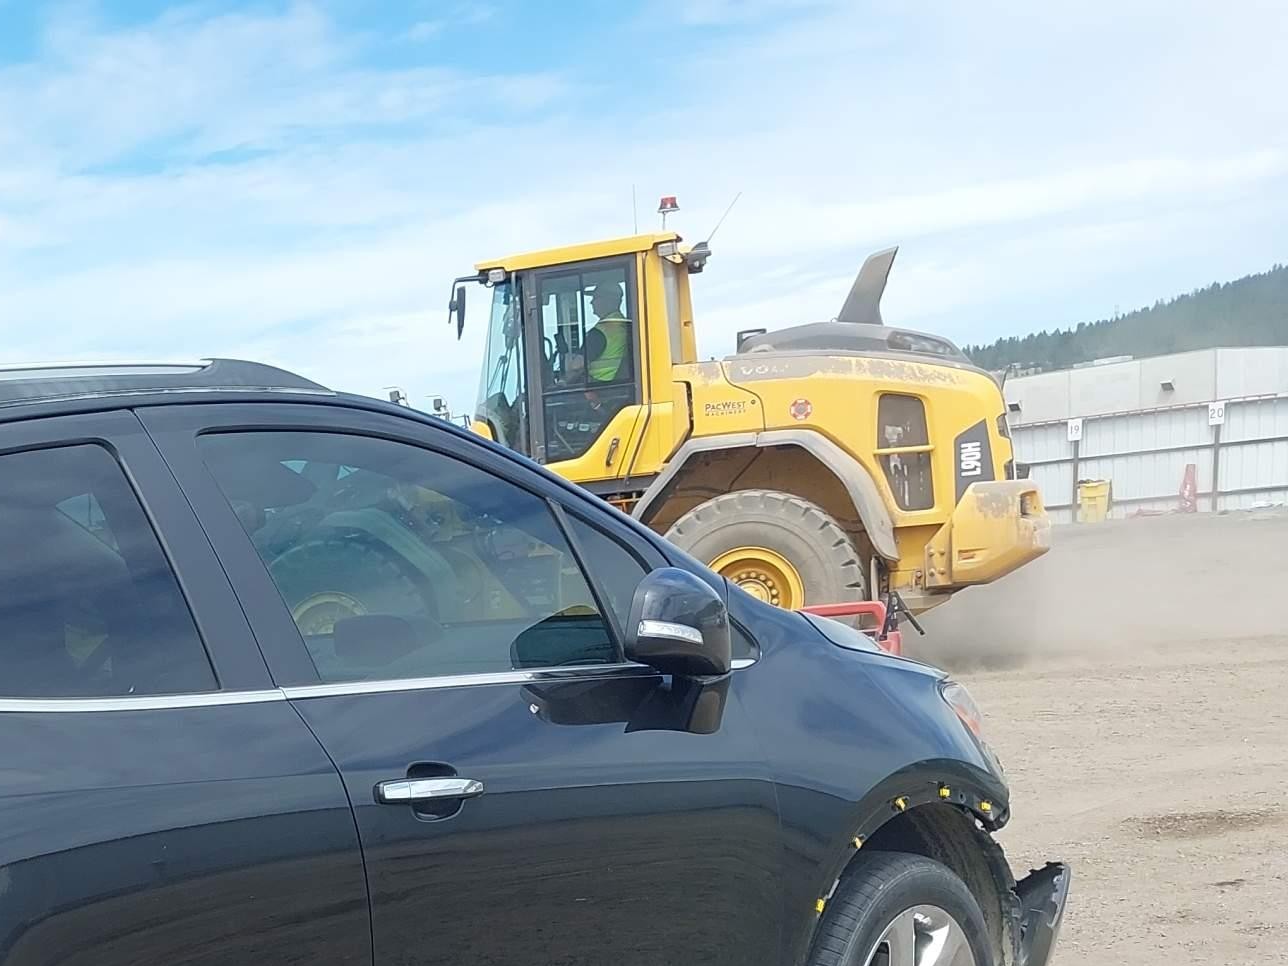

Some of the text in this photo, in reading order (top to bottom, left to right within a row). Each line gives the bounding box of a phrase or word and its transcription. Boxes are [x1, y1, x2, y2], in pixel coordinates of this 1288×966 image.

[1209, 407, 1224, 419] 20
[1070, 424, 1080, 435] 19
[960, 441, 982, 477] L90H
